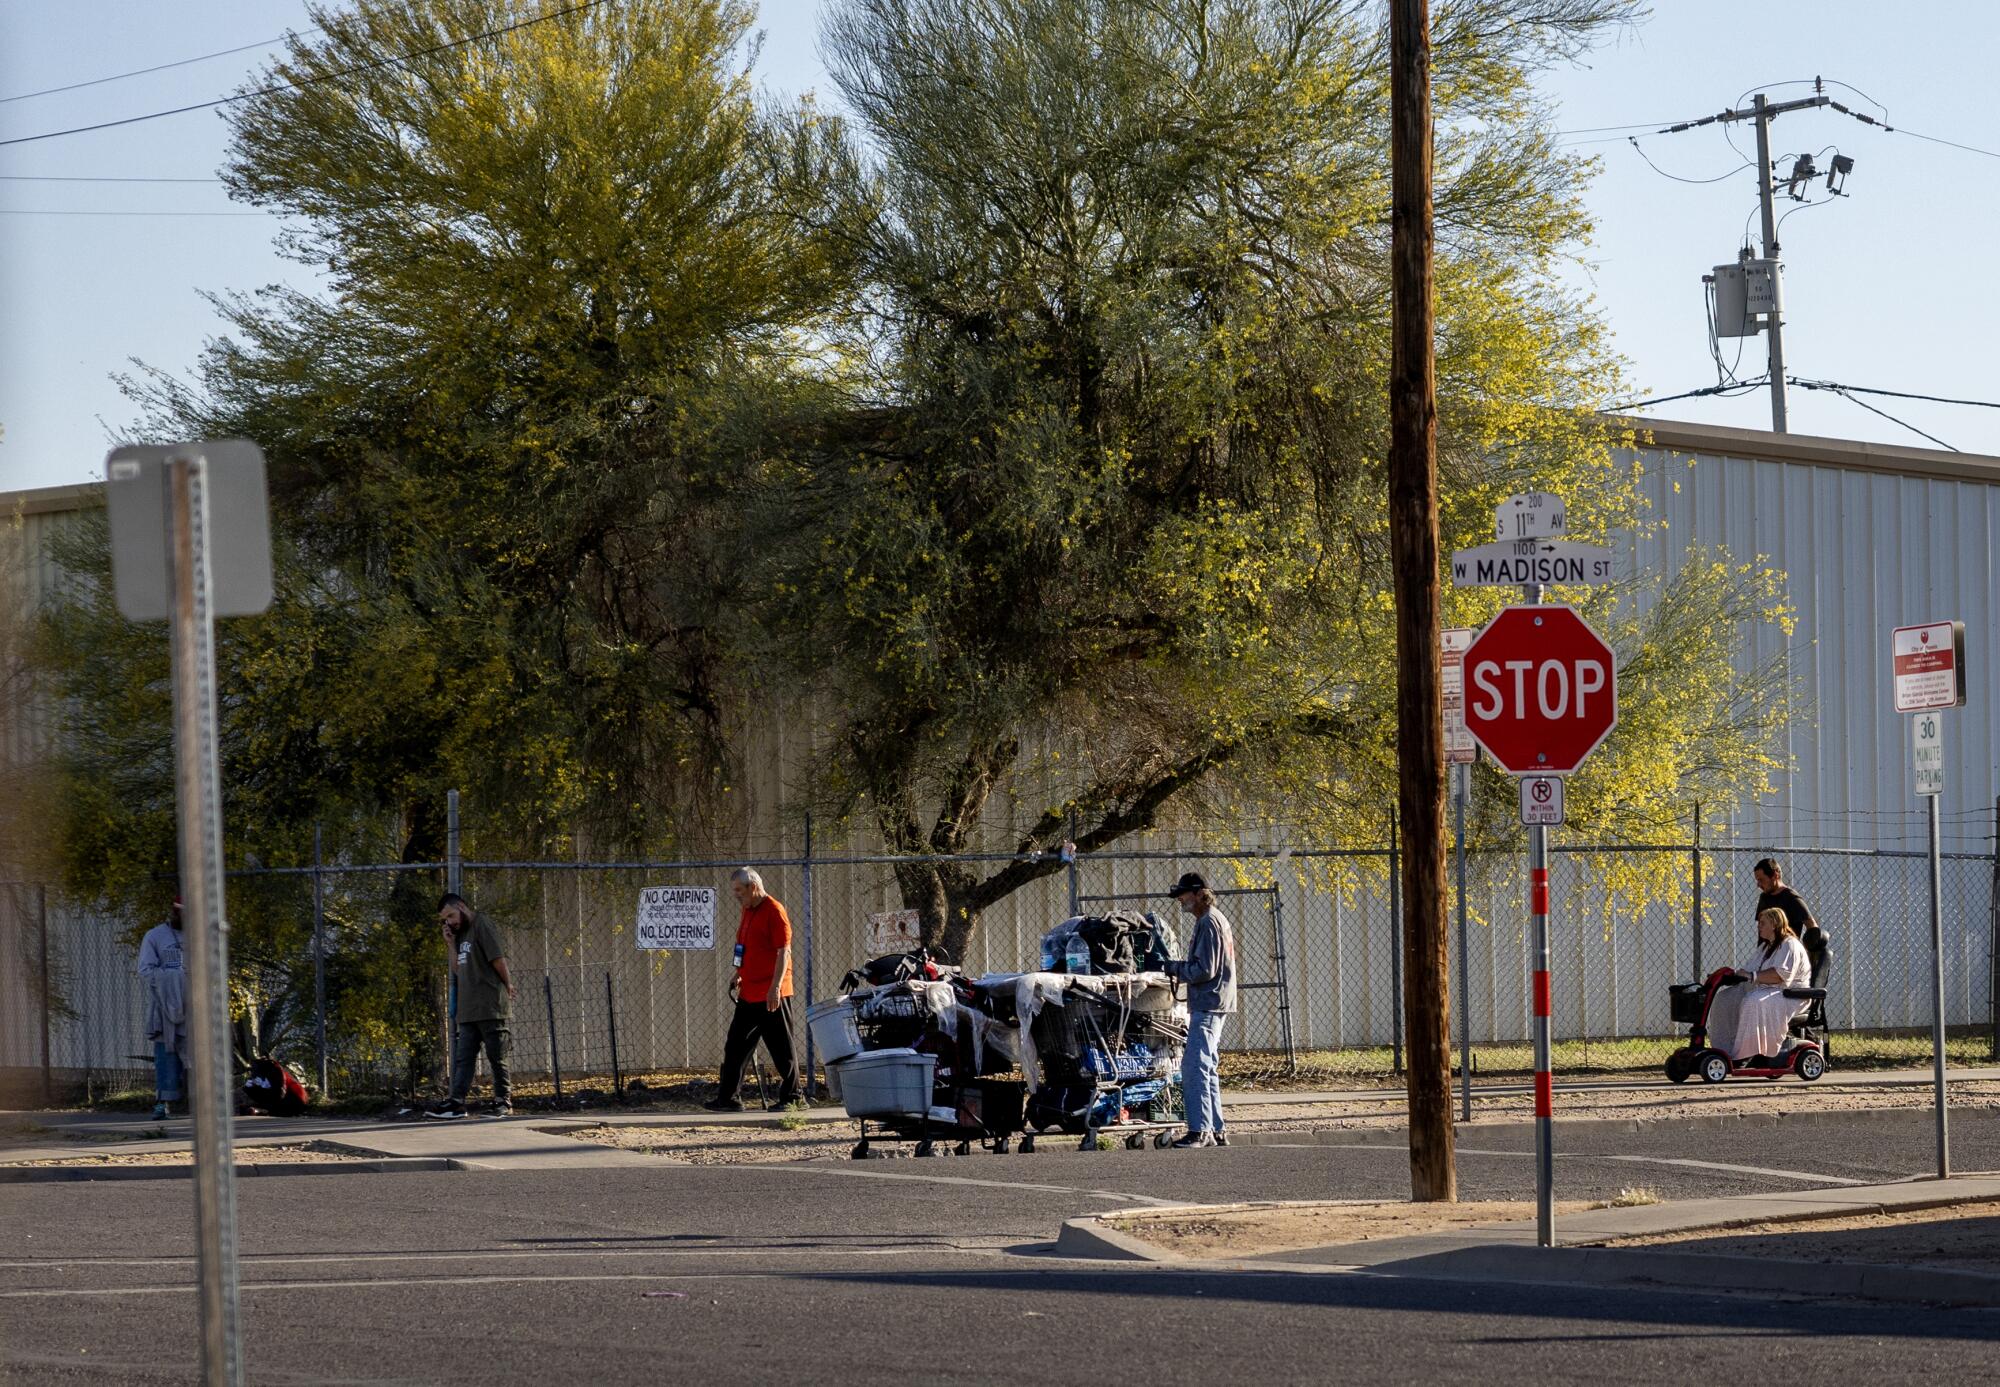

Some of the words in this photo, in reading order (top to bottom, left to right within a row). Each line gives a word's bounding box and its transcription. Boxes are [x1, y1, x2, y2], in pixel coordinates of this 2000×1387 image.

[1528, 496, 1543, 509] 200
[1498, 519, 1504, 535] S
[1516, 512, 1535, 536] 11TH
[1551, 513, 1564, 529] AV
[1513, 543, 1536, 556] 1100
[1454, 563, 1467, 579] W
[1477, 558, 1584, 583] MADISON
[1593, 561, 1611, 577] ST
[1472, 658, 1606, 721] STOP
[1920, 720, 1936, 739] 30
[1916, 745, 1940, 762] MINUTE
[1916, 768, 1942, 784] PARKING
[1531, 804, 1554, 812] WITHIN
[1527, 813, 1537, 821] 30
[1540, 812, 1557, 821] FEET
[644, 890, 659, 904] NO
[662, 890, 710, 904] CAMPING
[640, 925, 655, 939] NO
[658, 925, 711, 939] LOITERING
